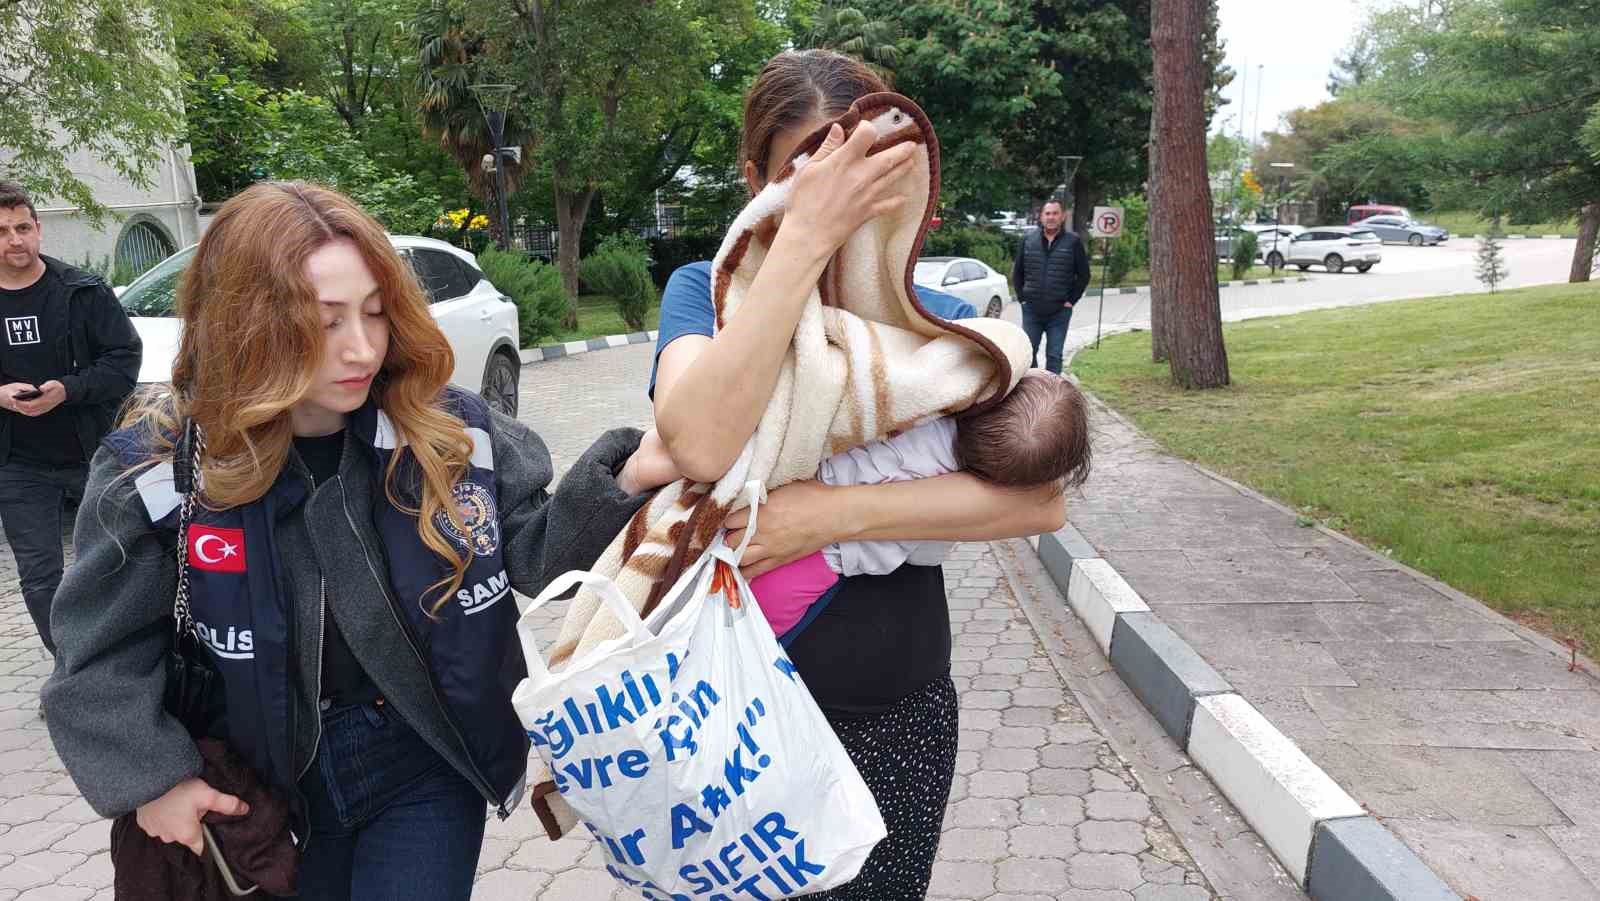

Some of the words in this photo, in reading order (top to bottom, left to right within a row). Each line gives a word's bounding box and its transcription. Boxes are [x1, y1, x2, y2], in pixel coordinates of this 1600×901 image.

[12, 320, 31, 331] MV
[15, 331, 34, 341] TR
[456, 570, 509, 608] SAM
[196, 622, 254, 651] OLİS
[679, 811, 799, 895] SIFIR
